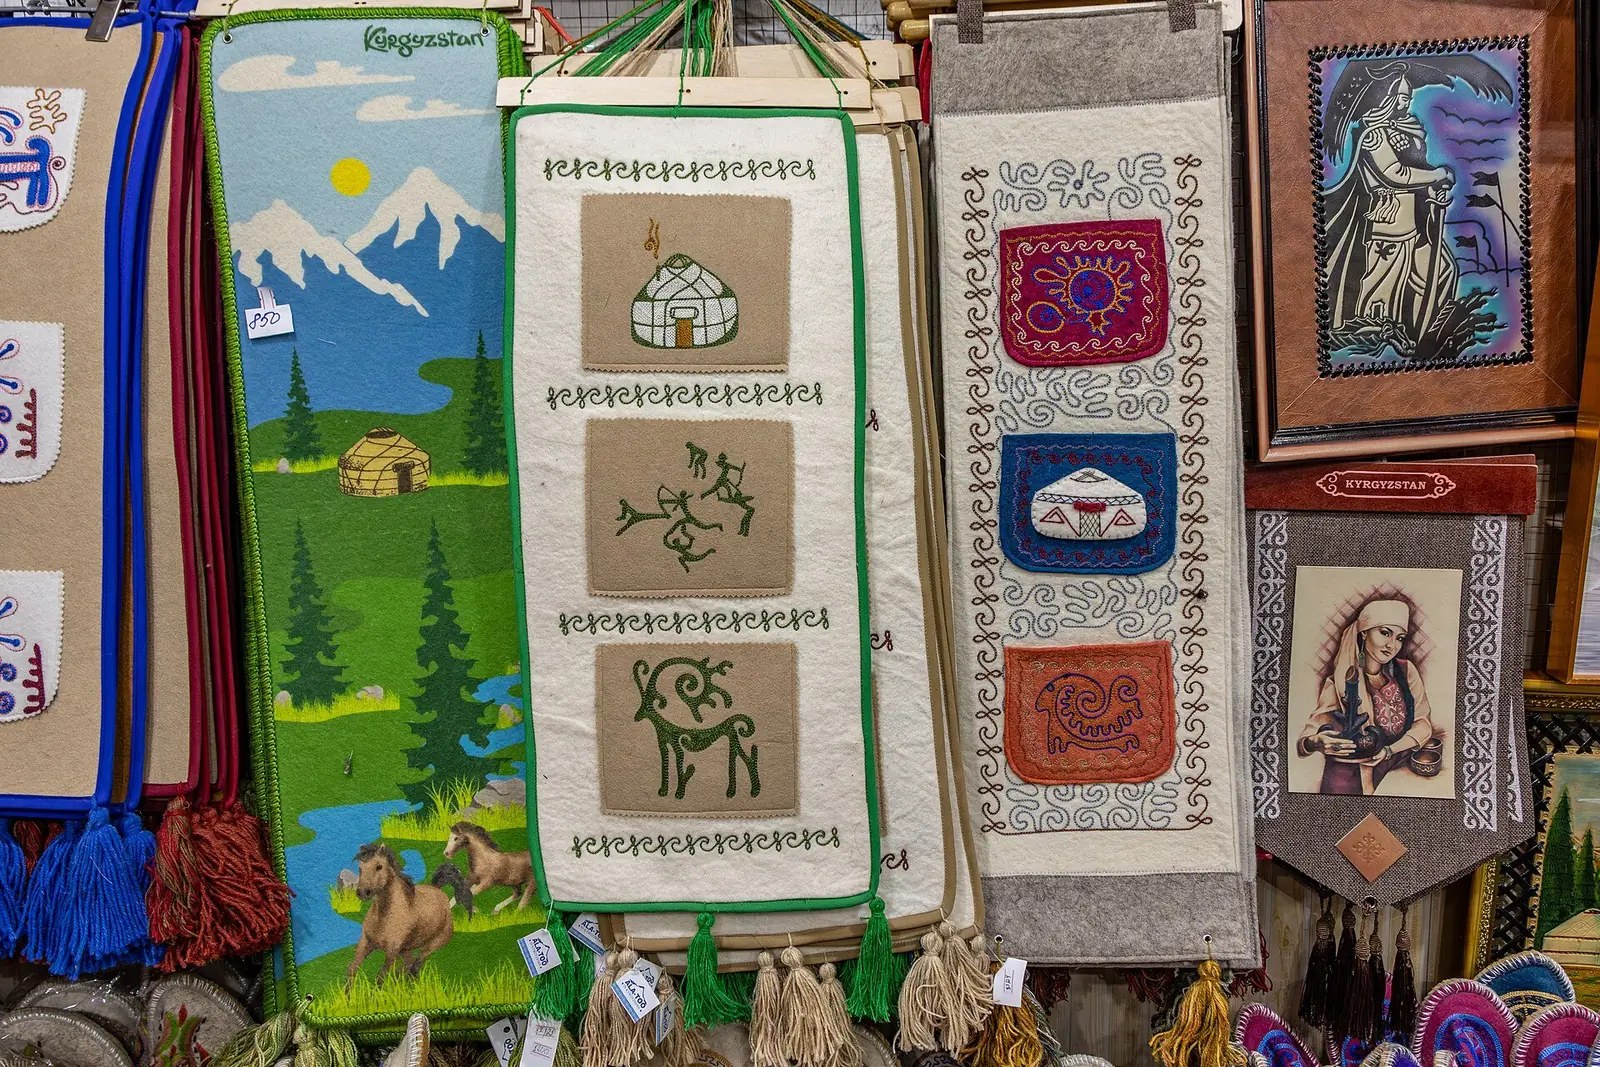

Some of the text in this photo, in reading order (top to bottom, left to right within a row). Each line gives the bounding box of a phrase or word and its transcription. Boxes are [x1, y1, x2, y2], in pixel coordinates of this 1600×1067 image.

[249, 311, 281, 330] 850
[1345, 479, 1427, 490] KYRGYZSTAN
[580, 919, 601, 939] ALA-T
[531, 938, 549, 967] ALA-TOO
[623, 979, 648, 1010] ALA-TOO
